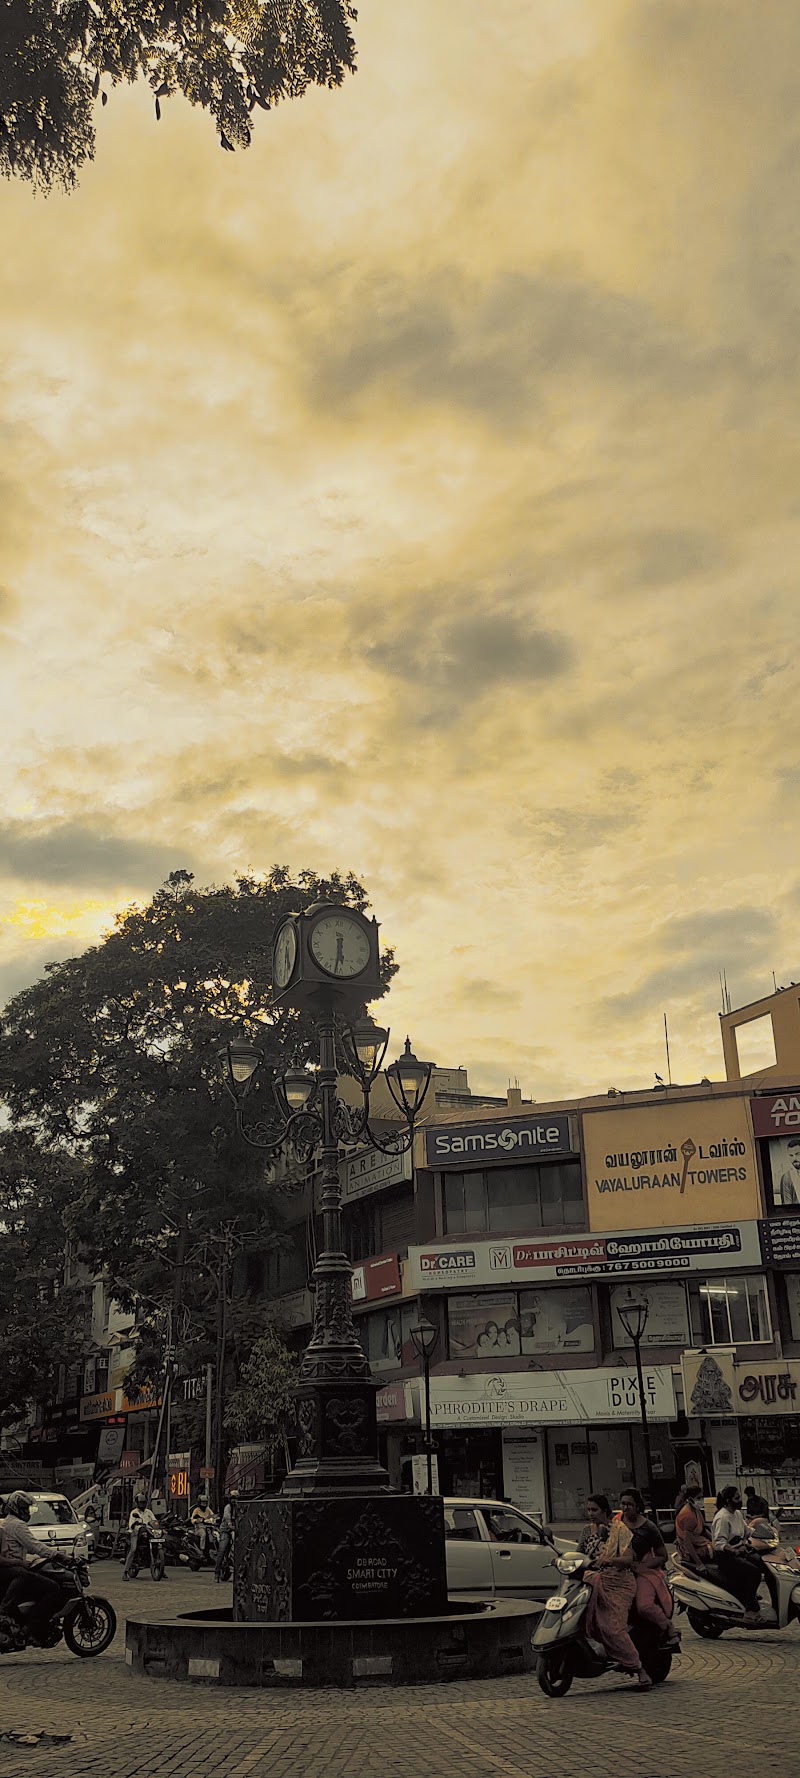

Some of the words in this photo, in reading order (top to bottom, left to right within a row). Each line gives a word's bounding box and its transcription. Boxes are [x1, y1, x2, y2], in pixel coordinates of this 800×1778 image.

[435, 1126, 560, 1154] Samsonite
[605, 1143, 678, 1169] வயலூரான்
[699, 1137, 746, 1160] டவர்ஸ்
[350, 1152, 396, 1176] AREN
[350, 1162, 400, 1189] ANIMATION
[595, 1172, 681, 1193] VAYALURAAN
[687, 1167, 747, 1185] TOWERS
[438, 1255, 475, 1269] CARE
[656, 1258, 689, 1267] 9000
[183, 1376, 207, 1400] TITA
[610, 1376, 656, 1391] PIXE
[738, 1373, 797, 1405] அரசு
[376, 1391, 397, 1408] arden
[519, 1399, 568, 1413] DRAPE
[612, 1391, 657, 1407] DUT
[368, 1557, 387, 1567] ROAD
[346, 1568, 375, 1580] SMART
[376, 1568, 398, 1579] CITY
[351, 1581, 389, 1590] COIMBATORE
